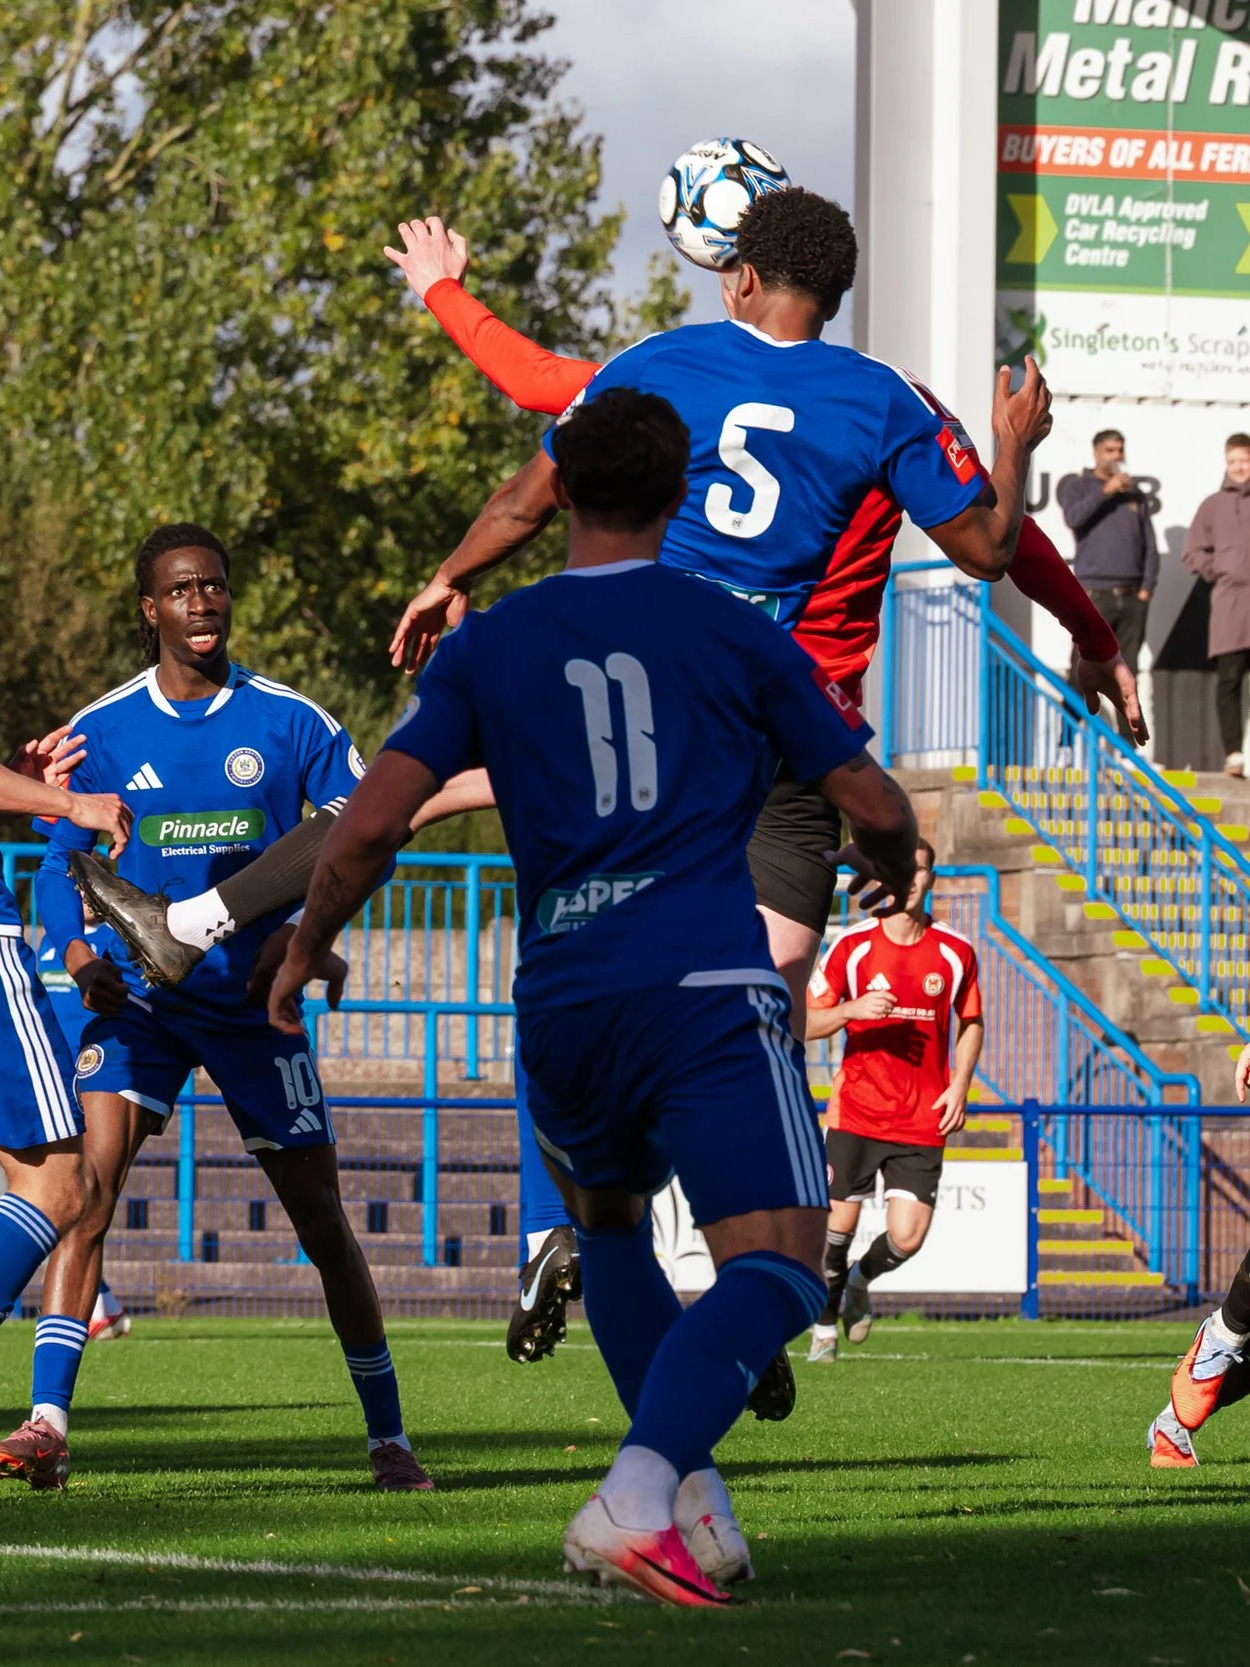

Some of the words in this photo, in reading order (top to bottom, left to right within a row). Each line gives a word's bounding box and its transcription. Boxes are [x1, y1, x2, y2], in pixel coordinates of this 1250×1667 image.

[1004, 31, 1197, 102] Metal
[1002, 133, 1105, 166] BUYERS
[1108, 137, 1146, 168] OF
[1148, 140, 1194, 170] ALL
[1064, 193, 1114, 217] DVLA
[1118, 196, 1209, 222] Approved
[1064, 218, 1099, 242] Car
[1101, 219, 1197, 250] Recycling
[1064, 242, 1129, 267] Centre
[1050, 327, 1179, 355] Singleton's
[705, 402, 795, 538] 5
[564, 652, 658, 818] 11
[159, 815, 249, 841] Pinnacle
[161, 845, 207, 857] Electrical
[209, 843, 250, 855] Supplies
[273, 1052, 321, 1110] 10
